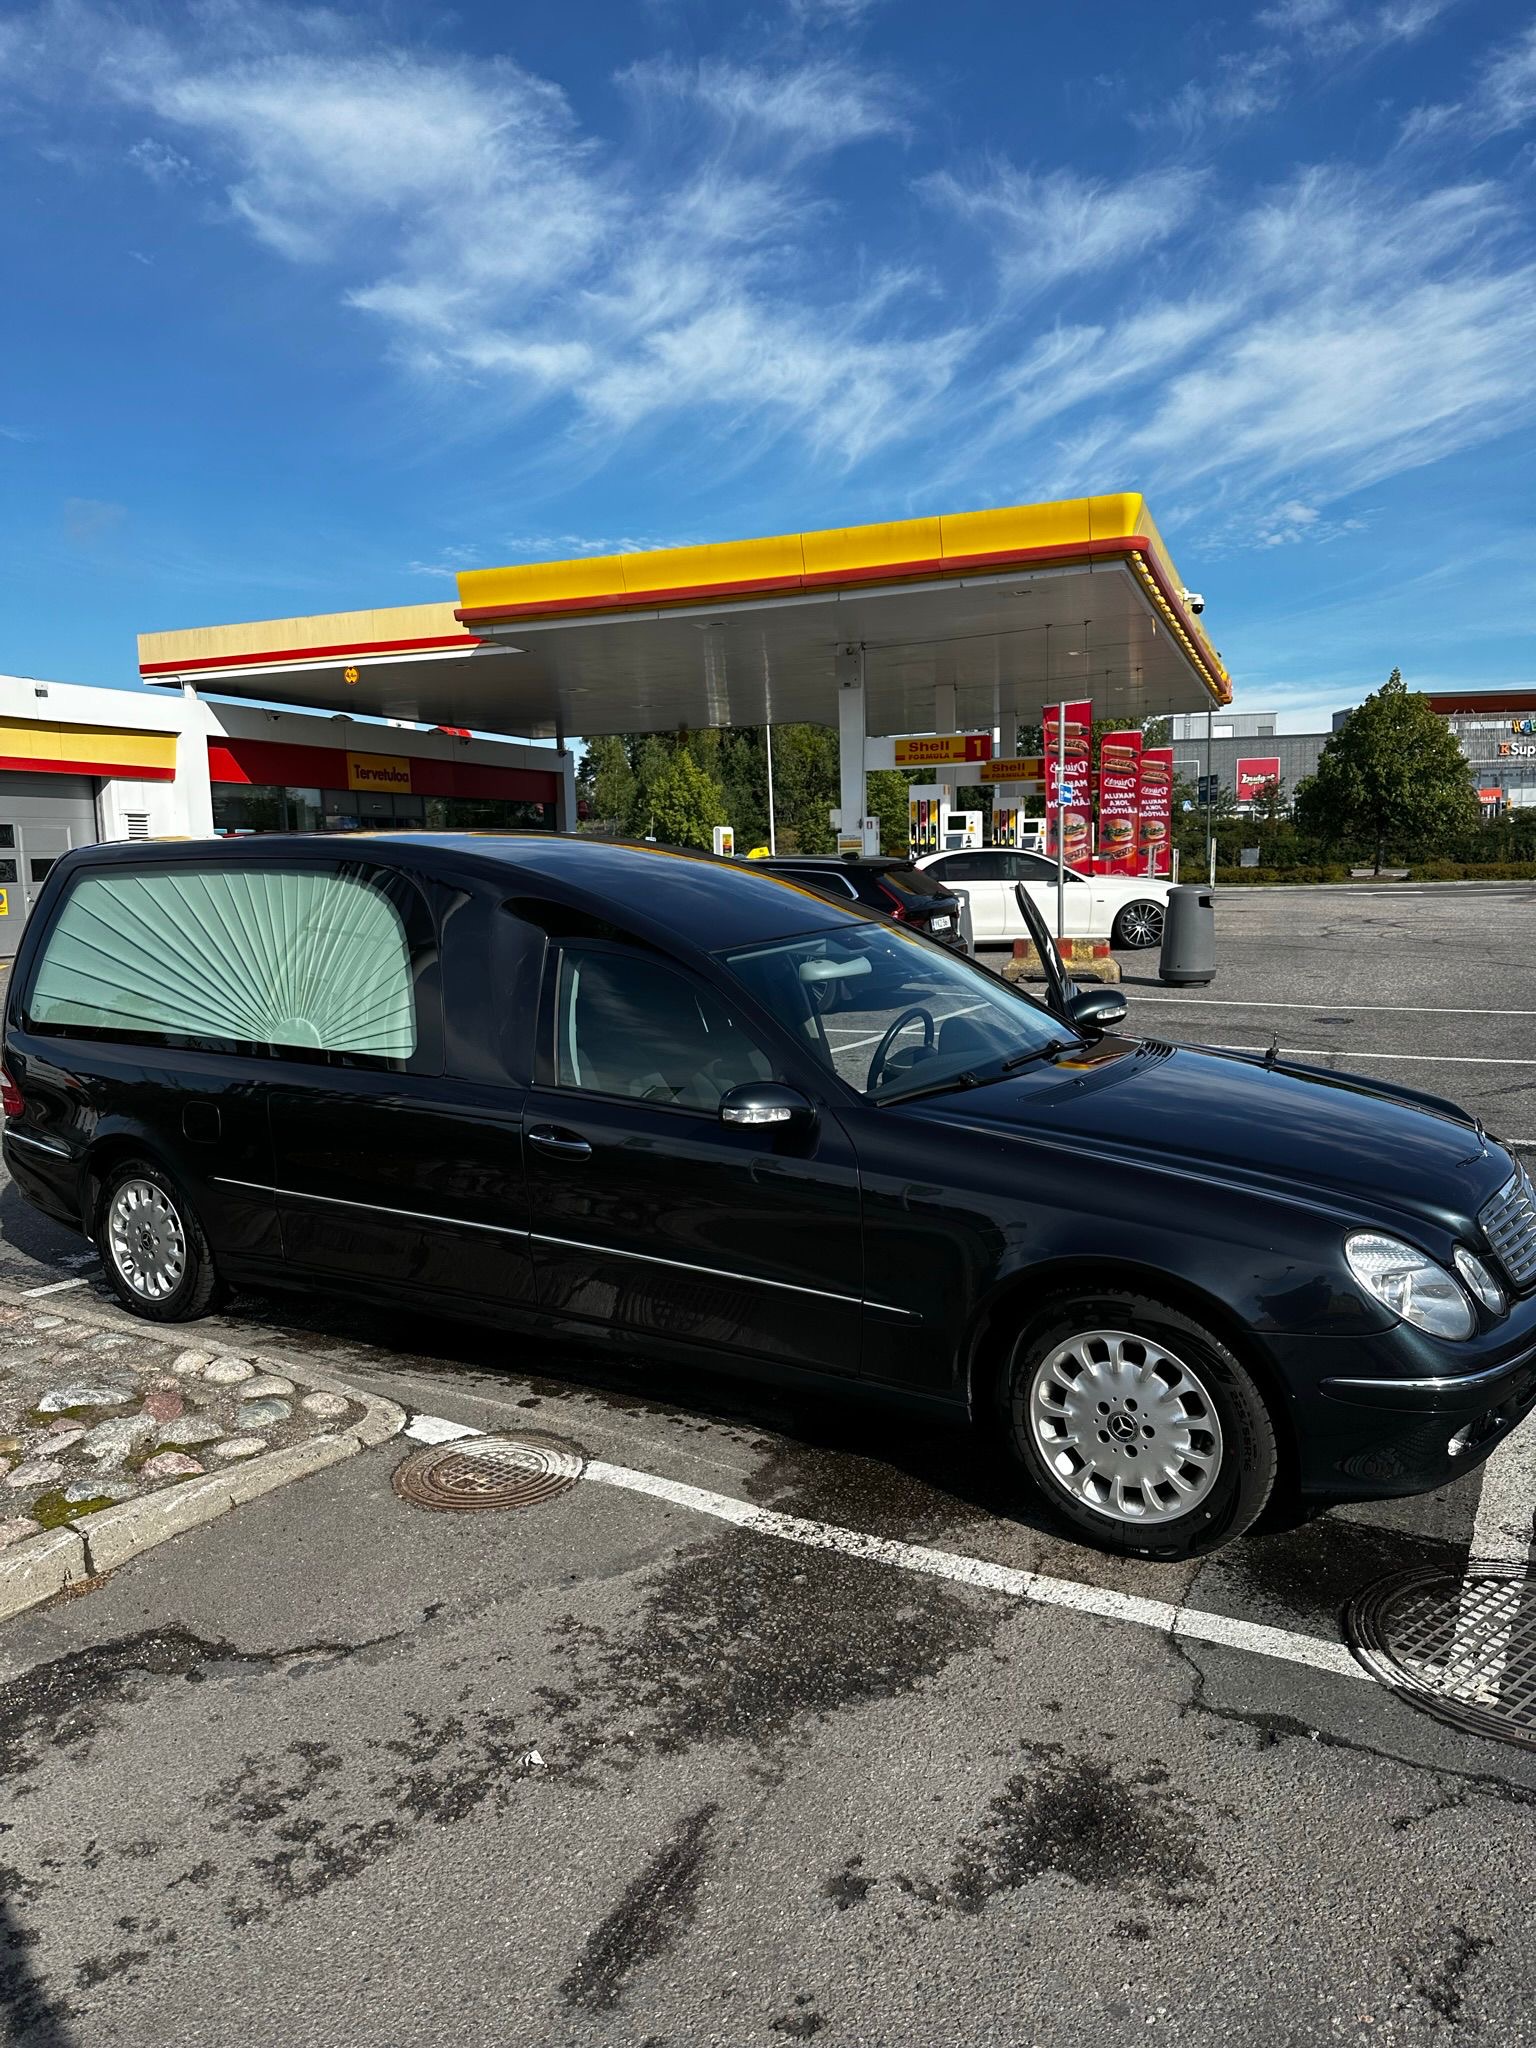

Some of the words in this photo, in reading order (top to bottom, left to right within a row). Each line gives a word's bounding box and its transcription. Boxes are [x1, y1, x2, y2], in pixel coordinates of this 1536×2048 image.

[908, 740, 950, 752] Shell
[974, 740, 981, 757] 1
[908, 752, 950, 761] FORMULA
[353, 764, 409, 783] Tervetuloa
[992, 763, 1025, 772] Shell
